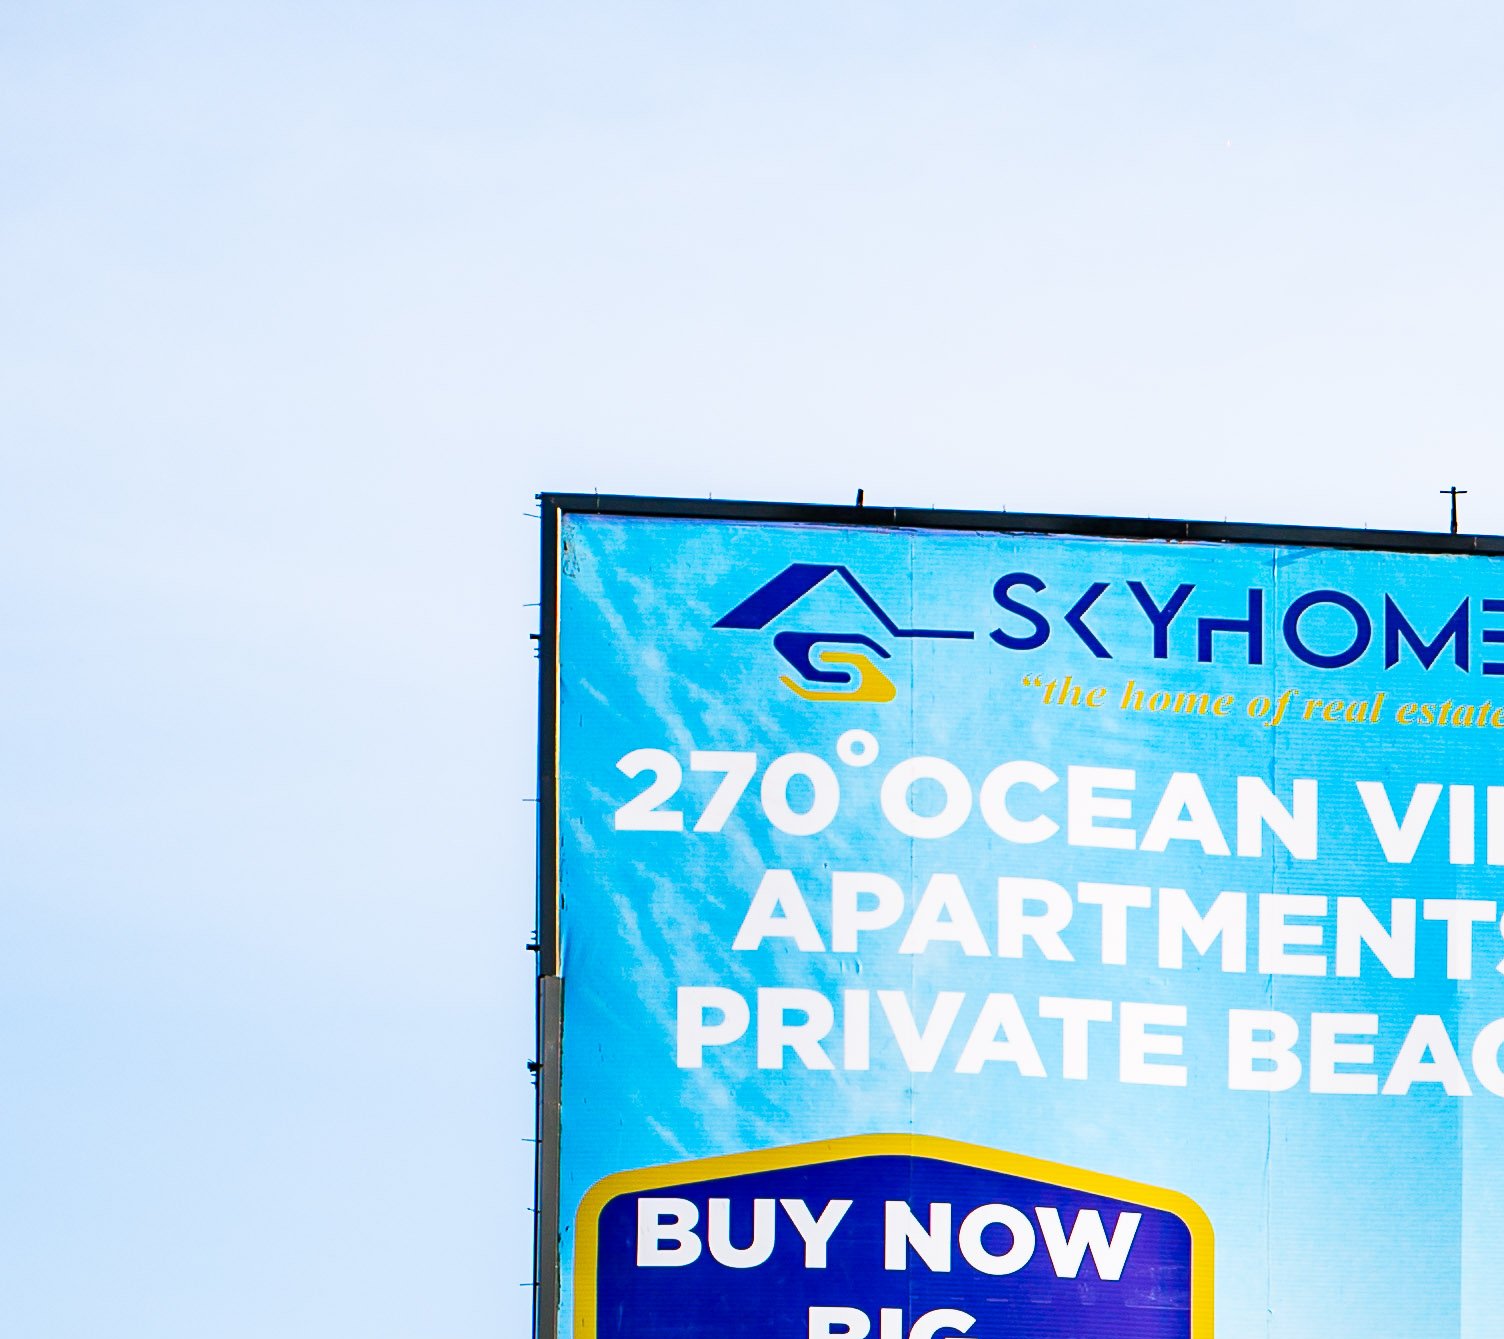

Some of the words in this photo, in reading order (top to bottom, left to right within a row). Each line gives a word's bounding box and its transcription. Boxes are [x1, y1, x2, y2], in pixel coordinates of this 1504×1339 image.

[1120, 679, 1232, 718] home
[1245, 688, 1301, 728] of
[1302, 692, 1386, 726] real
[675, 985, 1189, 1088] PRIVATE
[636, 1197, 854, 1270] BUY
[883, 1200, 1143, 1282] NOW
